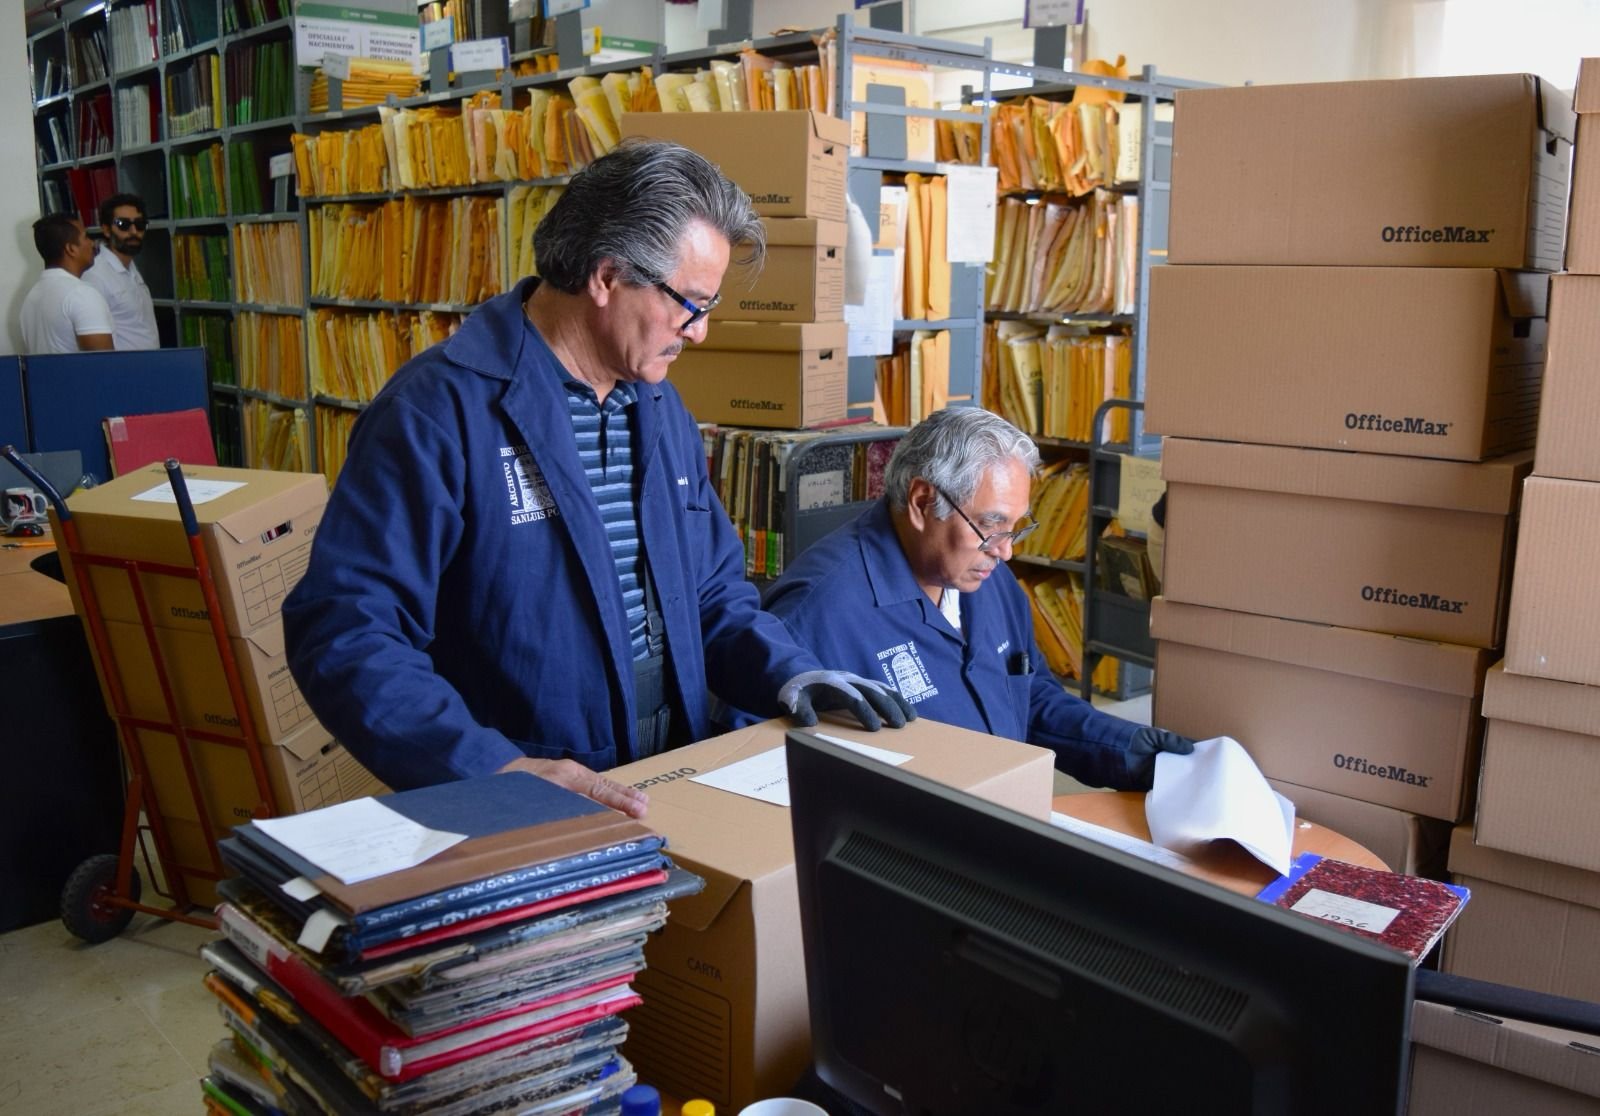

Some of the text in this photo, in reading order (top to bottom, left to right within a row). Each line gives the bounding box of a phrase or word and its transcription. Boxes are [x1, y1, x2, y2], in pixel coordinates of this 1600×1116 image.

[309, 41, 354, 50] NACIMIENTOS
[749, 193, 791, 204] iceMax
[1382, 226, 1493, 243] OfficeMax
[740, 300, 796, 311] OfficeMax
[730, 399, 785, 411] OfficeMax
[1345, 412, 1452, 437] OfficeMax
[503, 462, 519, 508] ARCHIVO
[1361, 585, 1466, 614] OfficeMax
[630, 766, 698, 791] Office
[1333, 754, 1432, 788] OfficeMax
[687, 957, 723, 983] CARTA
